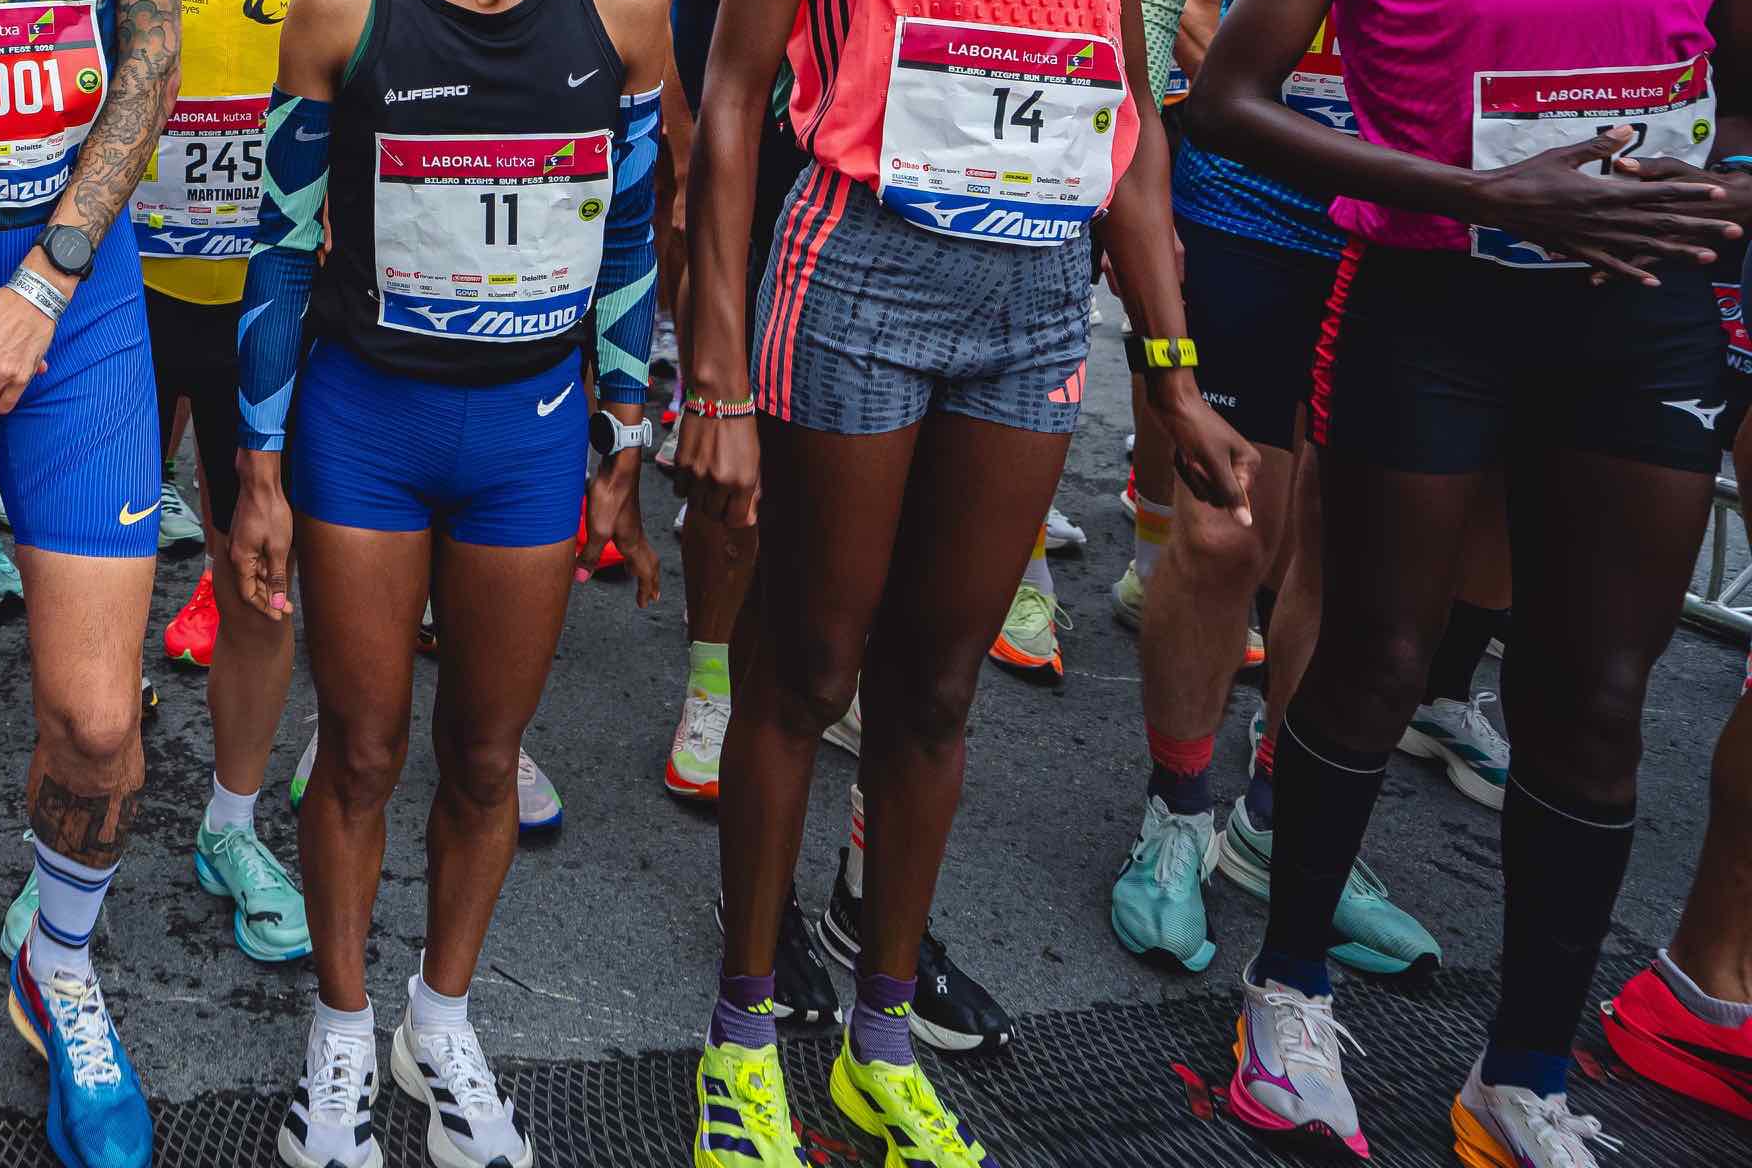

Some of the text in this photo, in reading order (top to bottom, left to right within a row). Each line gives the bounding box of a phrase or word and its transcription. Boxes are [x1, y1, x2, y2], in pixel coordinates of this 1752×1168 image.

[8, 45, 31, 54] FEST
[949, 42, 1058, 65] LABORAL kutxa
[949, 66, 985, 76] BILBAO
[991, 70, 1020, 80] NIGHT
[1024, 73, 1040, 82] RUN
[1044, 75, 1066, 84] FEST
[398, 84, 469, 102] LIFEPRO
[1536, 86, 1664, 103] LABORAL kutxa
[223, 112, 252, 122] kutxa
[993, 87, 1044, 143] 14
[15, 144, 42, 152] Deloitte
[185, 140, 263, 184] 245
[422, 156, 535, 167] LABORAL kutxa
[424, 177, 460, 185] BILBAO
[464, 177, 494, 185] NIGHT
[499, 177, 517, 185] RUN
[522, 176, 544, 184] FEST
[1036, 176, 1061, 185] Deloitte
[187, 186, 259, 202] MARTINDIAZ
[480, 193, 518, 246] 11
[200, 235, 253, 254] MIZ
[521, 274, 547, 282] Deloitte
